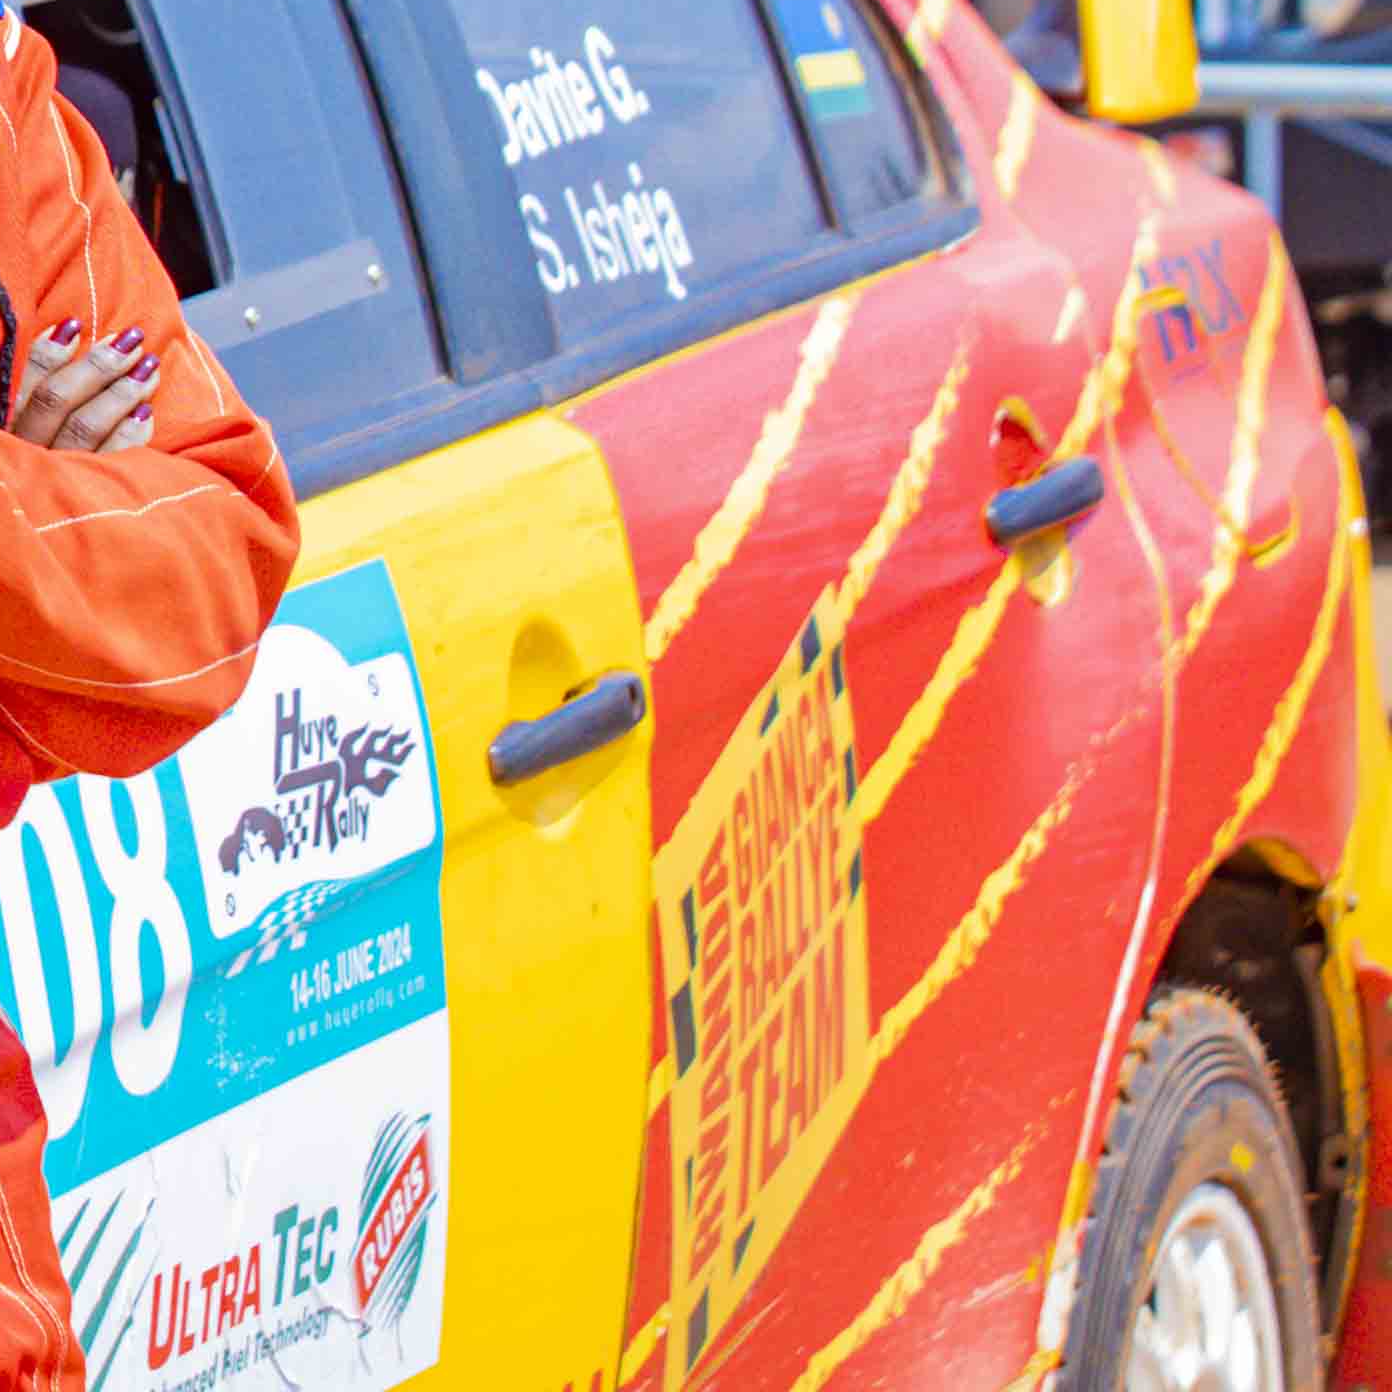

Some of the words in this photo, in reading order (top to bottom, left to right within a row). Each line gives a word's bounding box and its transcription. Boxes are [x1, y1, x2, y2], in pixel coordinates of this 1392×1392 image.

[583, 25, 650, 124] G.
[519, 193, 579, 294] S.
[563, 161, 693, 301] Isheja
[274, 688, 338, 784] Huye
[730, 662, 837, 912] GIANCA
[276, 760, 370, 854] Rally
[290, 959, 332, 1013] 14-16
[334, 938, 375, 995] JUNE
[376, 922, 412, 975] 2024
[736, 813, 844, 1032] RALLYE
[733, 916, 846, 1222] TEAM
[272, 1203, 339, 1307] TEC
[359, 1153, 425, 1291] RUBIS
[147, 1243, 262, 1371] ULTRA
